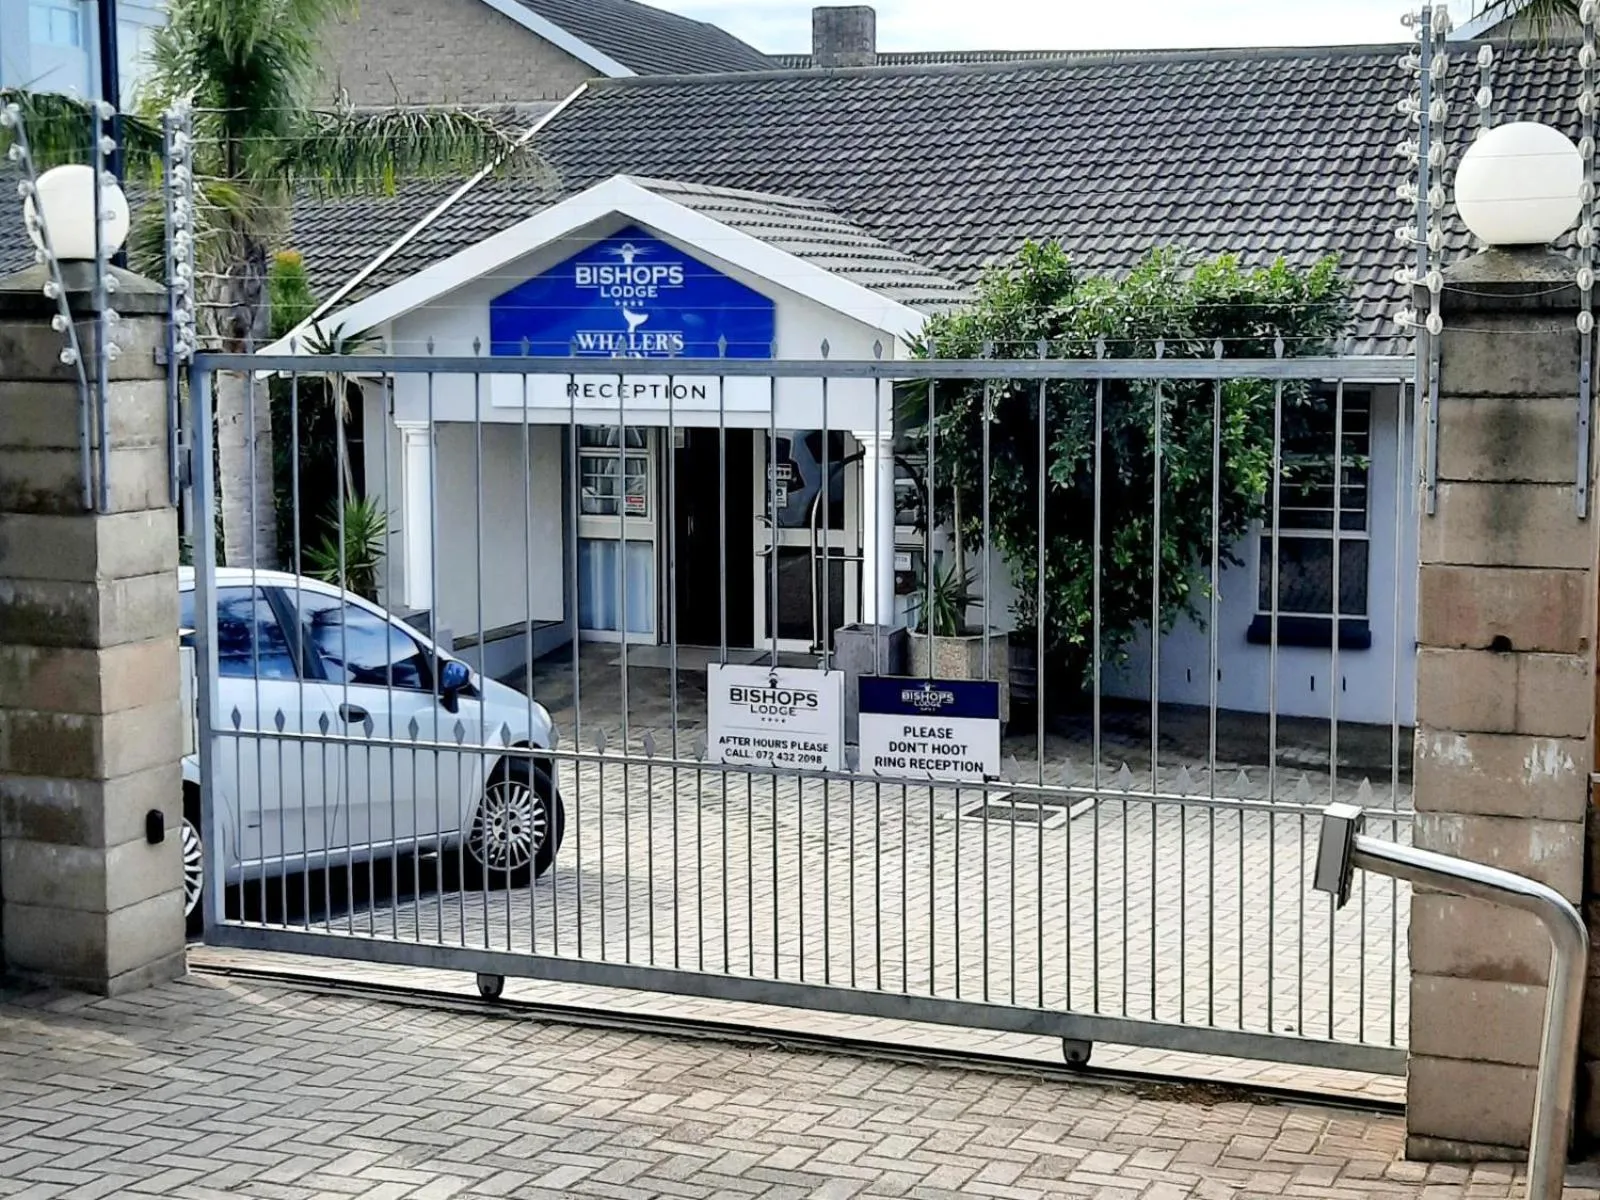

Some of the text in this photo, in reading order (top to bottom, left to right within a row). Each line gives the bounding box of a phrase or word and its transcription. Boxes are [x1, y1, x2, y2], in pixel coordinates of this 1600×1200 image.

[575, 266, 685, 285] BISHOPS
[600, 286, 658, 298] LODGE
[566, 383, 706, 400] RECEPTION
[729, 687, 819, 708] BISHOPS
[901, 690, 955, 703] BISHOPS
[750, 704, 798, 717] LODGE
[903, 725, 954, 740] PLEASE
[719, 735, 829, 753] AFTER HOURS PLEASE
[889, 741, 968, 756] DON'T HOOT
[755, 750, 774, 760] 072
[776, 752, 795, 763] 432
[874, 756, 984, 773] RING RECEPTION
